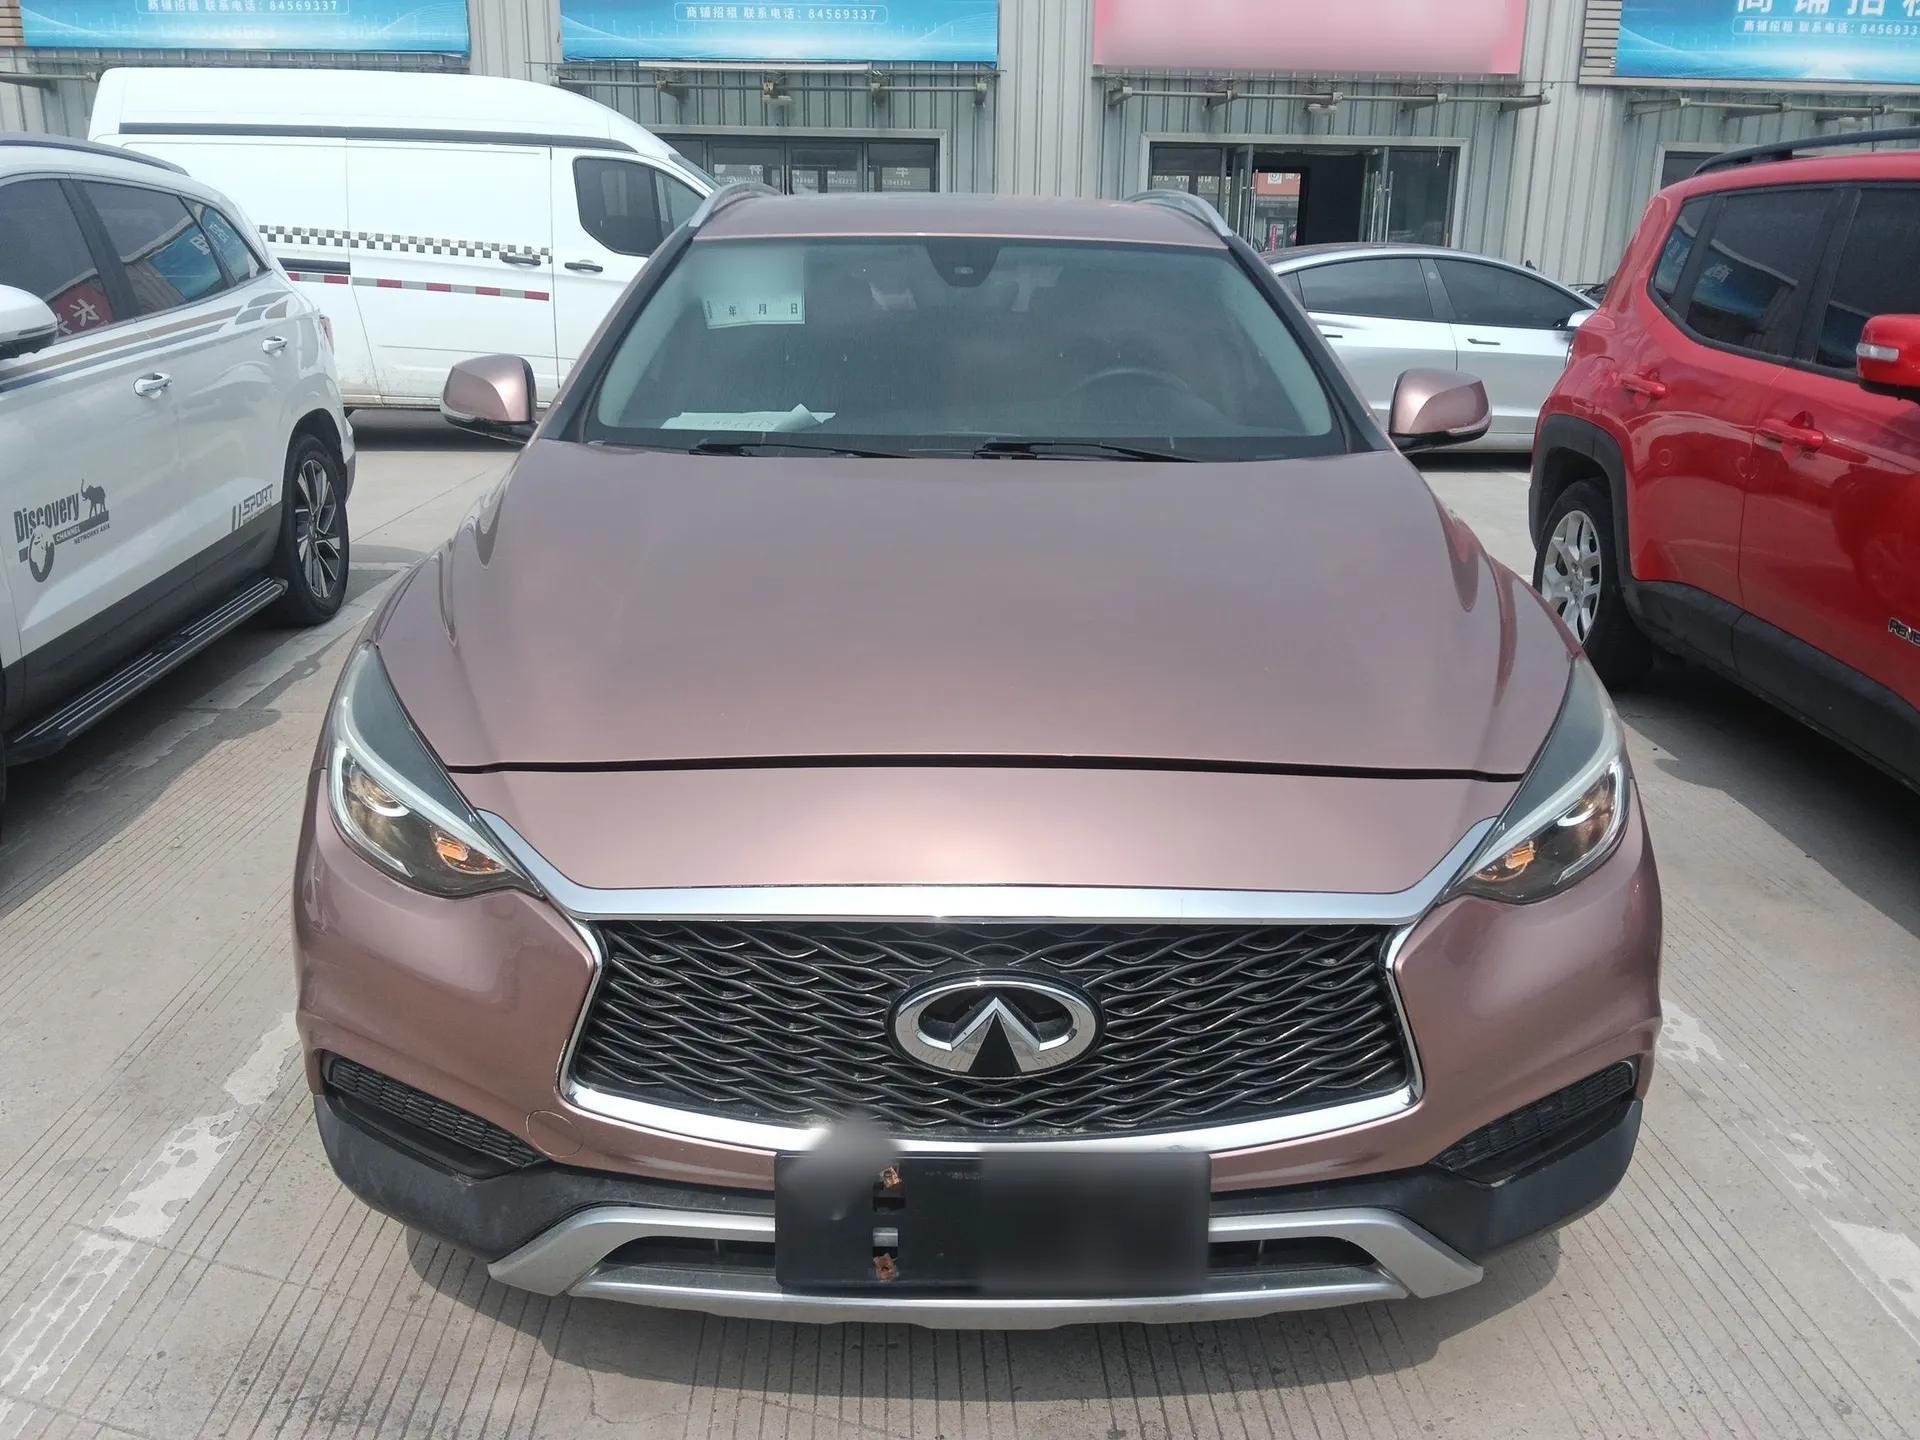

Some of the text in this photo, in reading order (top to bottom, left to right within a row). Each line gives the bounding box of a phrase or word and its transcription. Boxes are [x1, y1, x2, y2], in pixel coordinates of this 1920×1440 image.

[1799, 21, 1920, 35] 联系电话：8456933
[728, 303, 798, 317] 年 月 日
[242, 483, 273, 517] SPORT
[14, 492, 80, 544] Discovery
